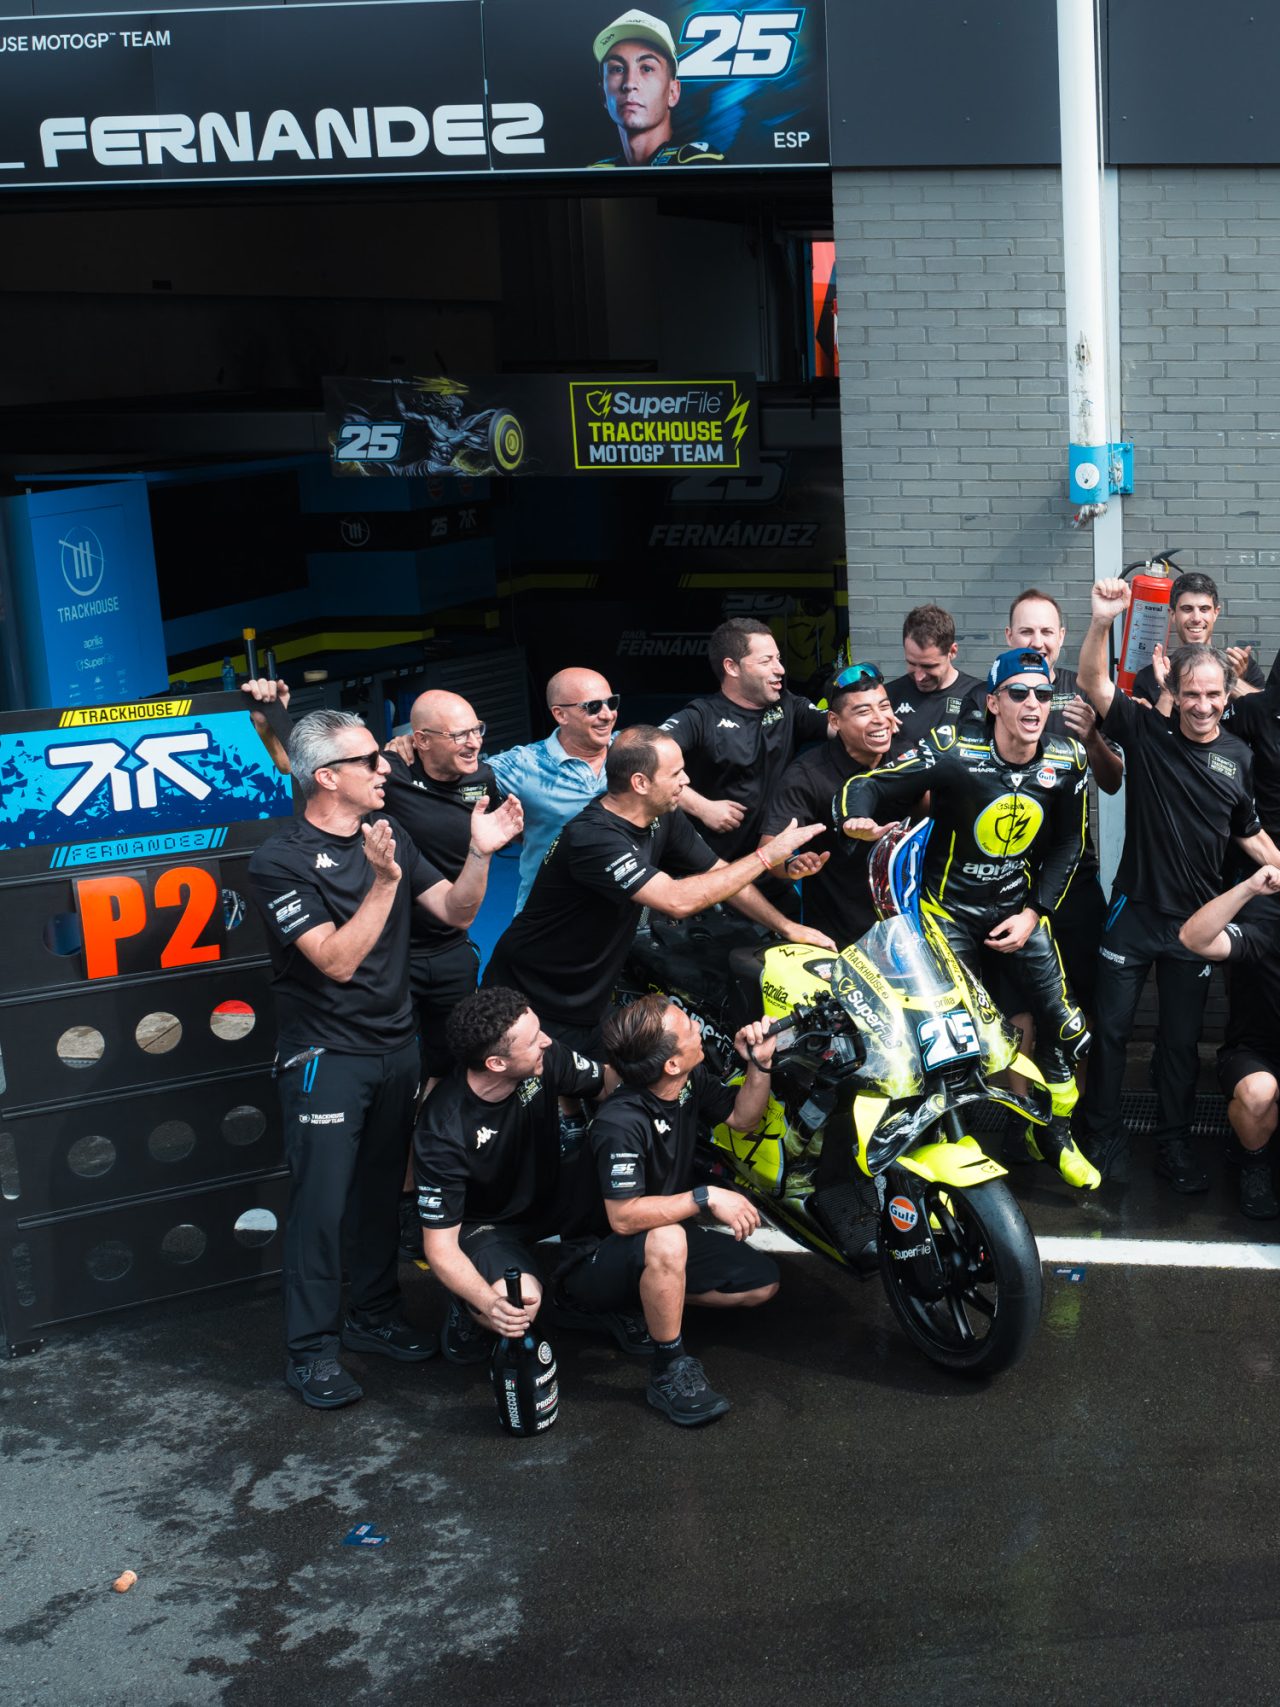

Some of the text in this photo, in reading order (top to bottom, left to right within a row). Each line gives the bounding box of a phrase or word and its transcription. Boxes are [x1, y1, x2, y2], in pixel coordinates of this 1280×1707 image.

[120, 30, 171, 47] TEAM
[677, 9, 804, 80] 25
[774, 132, 810, 149] ESP
[336, 423, 404, 462] 25
[588, 420, 722, 442] TRACKHOUSE
[673, 443, 724, 463] TEAM
[647, 519, 821, 548] FERNÁNDEZ
[57, 596, 120, 623] TRACKHOUSE
[79, 702, 173, 724] TRACKHOUSE
[1038, 771, 1055, 782] Gulf
[77, 866, 220, 980] P2
[843, 949, 886, 993] TRACKHOUSE
[763, 980, 789, 1004] aprilia
[931, 996, 956, 1009] prilia
[917, 1010, 981, 1071] 25
[890, 1204, 916, 1223] Gulf
[894, 1244, 931, 1260] SuperFile
[506, 1391, 520, 1428] PROSECCO
